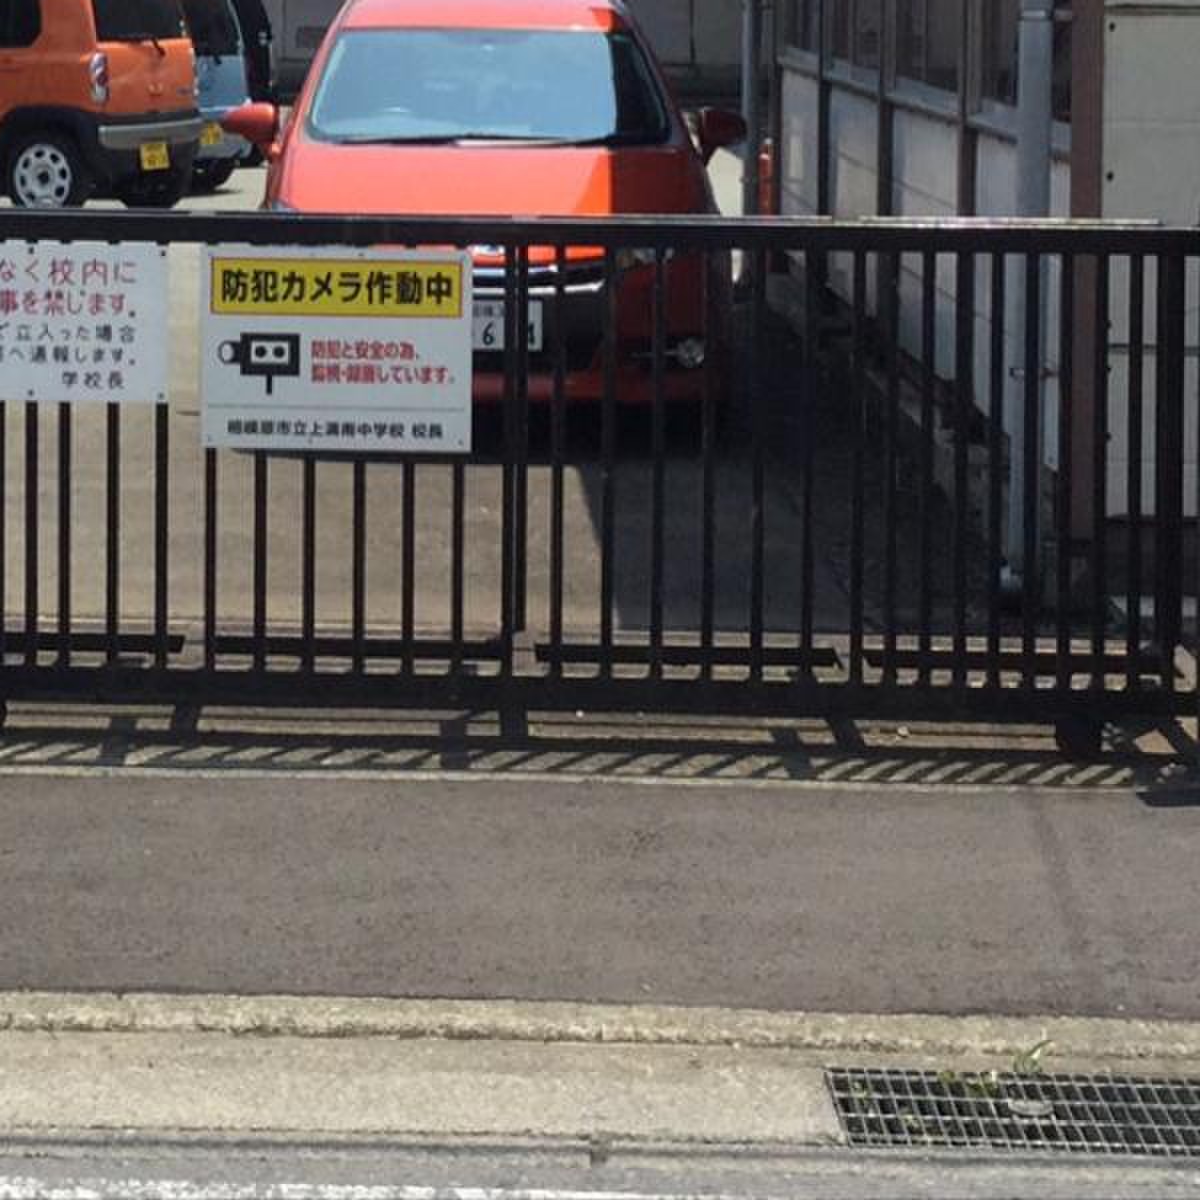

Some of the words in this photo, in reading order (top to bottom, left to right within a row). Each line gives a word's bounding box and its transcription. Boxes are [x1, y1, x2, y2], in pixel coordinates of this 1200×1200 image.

[222, 268, 452, 305] 防犯カメラ作動中
[62, 370, 125, 390] 学校長
[411, 422, 443, 439] 校長
